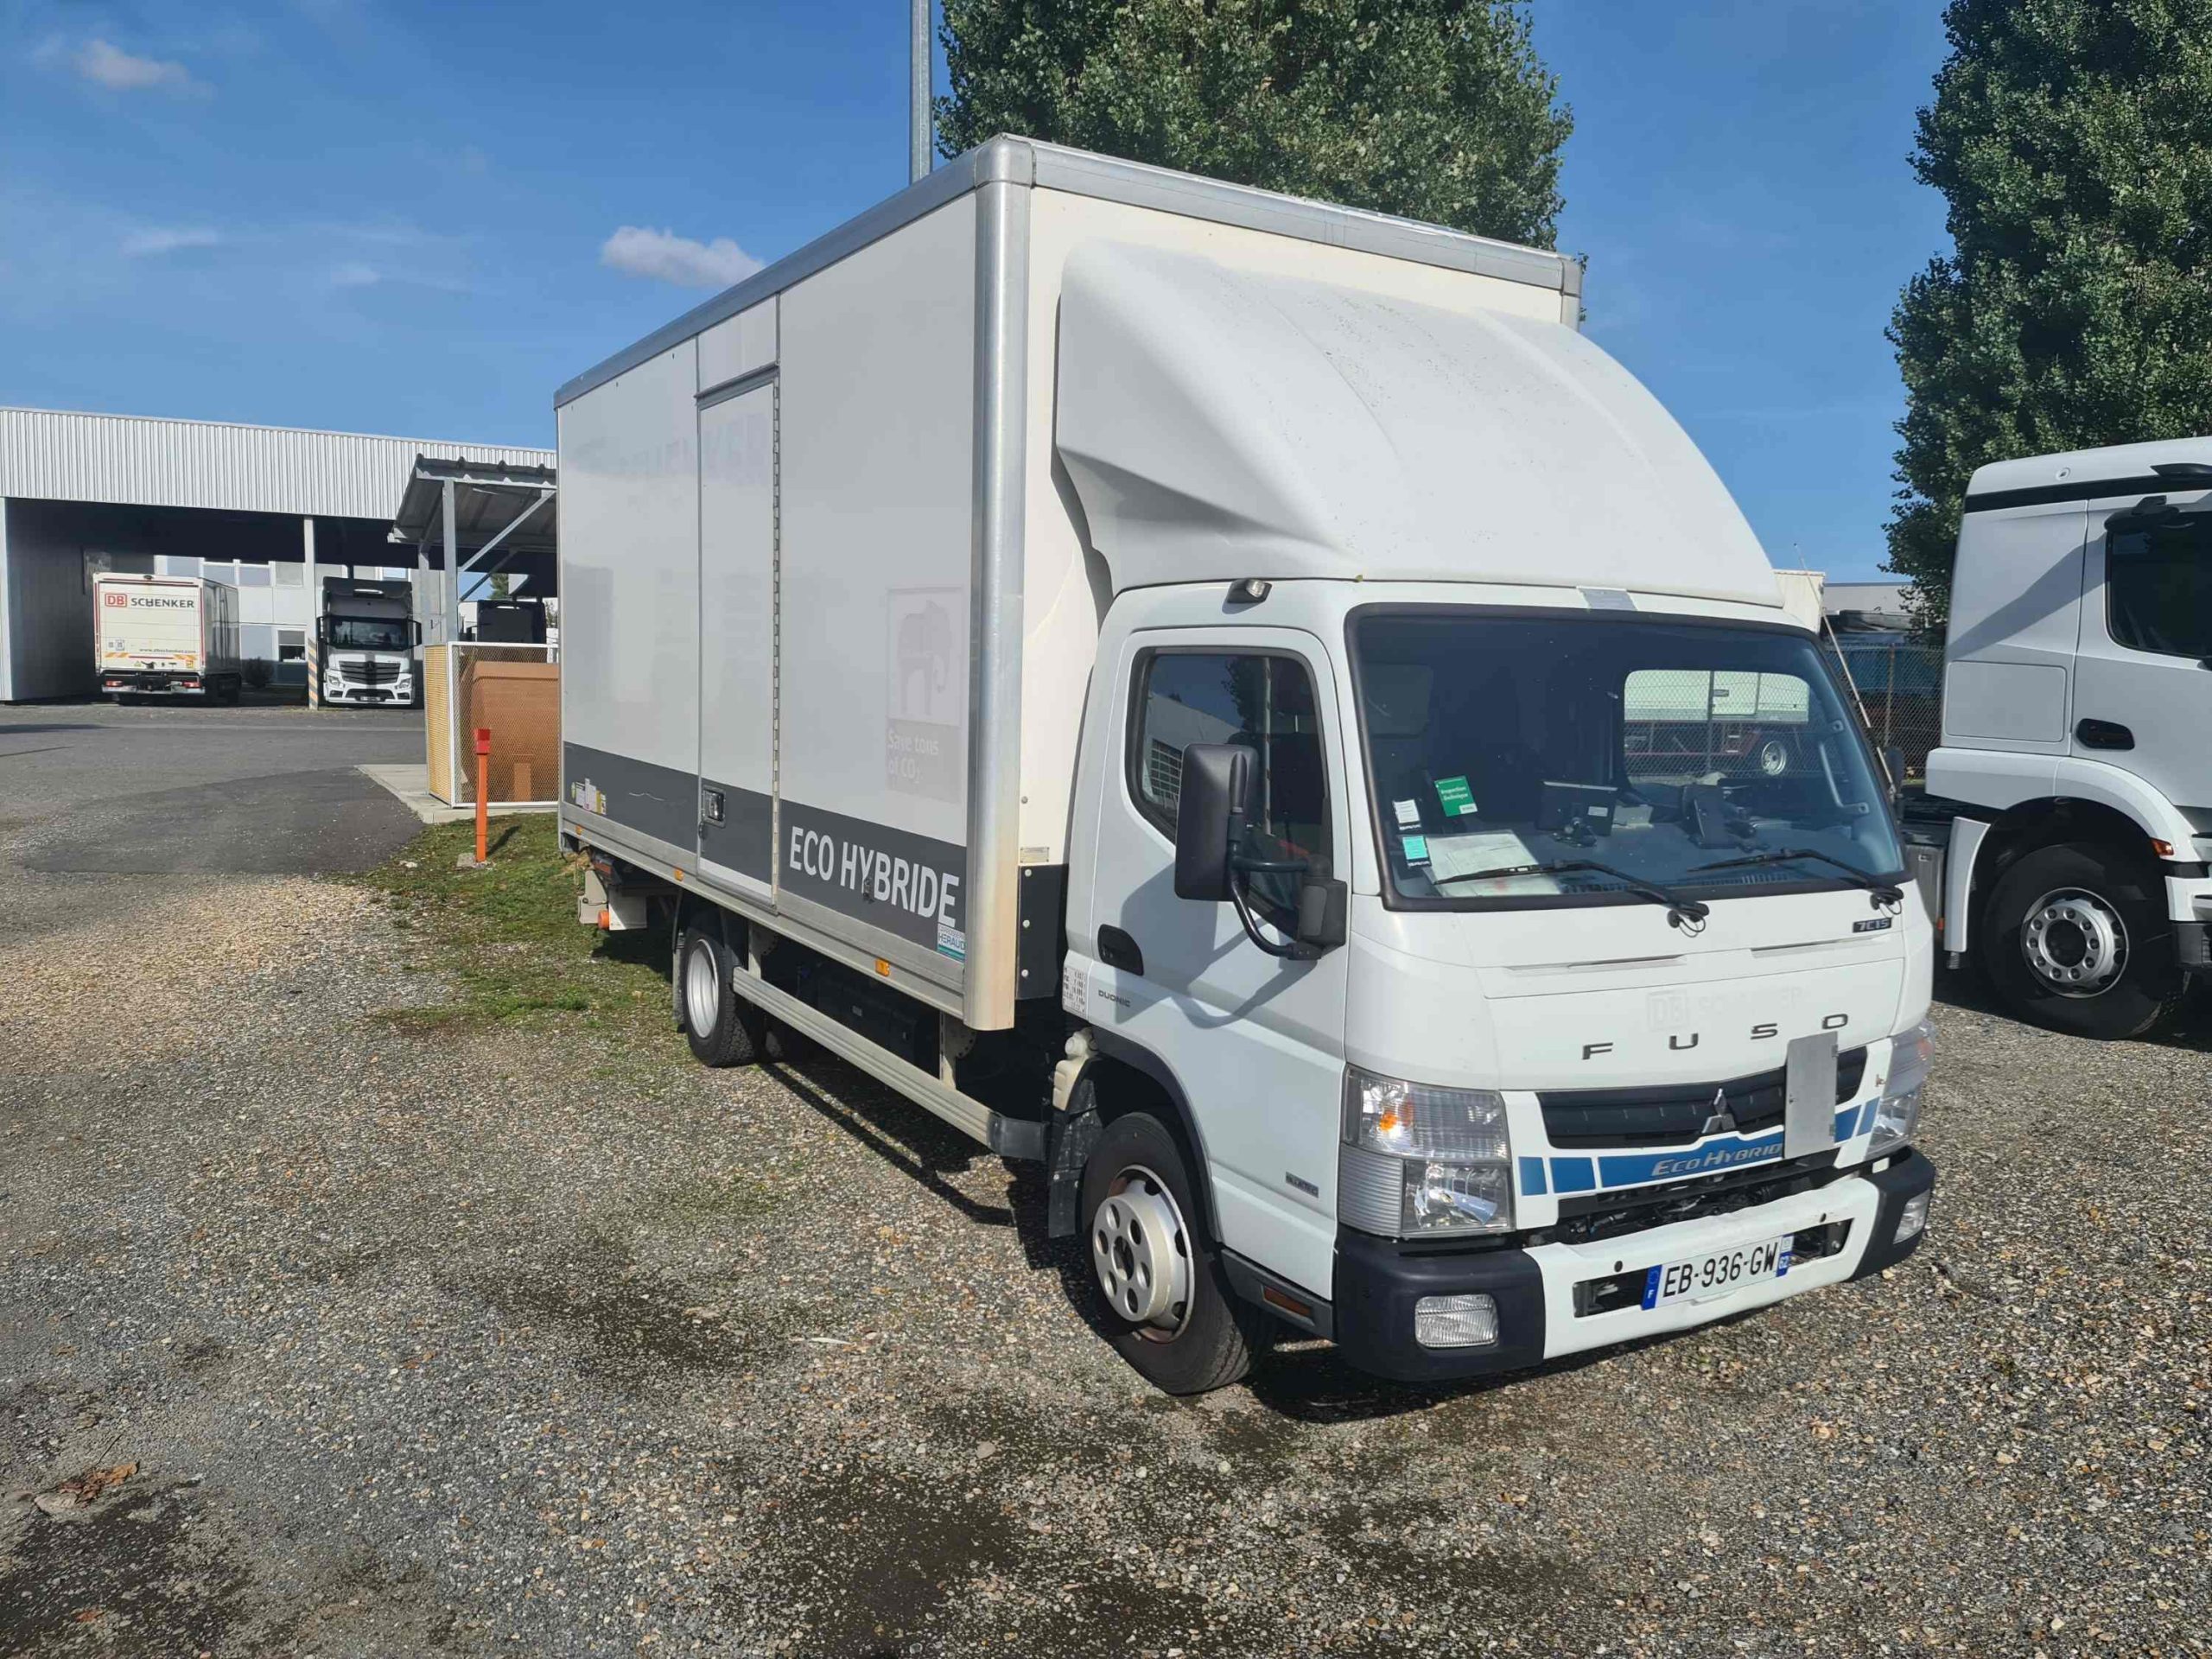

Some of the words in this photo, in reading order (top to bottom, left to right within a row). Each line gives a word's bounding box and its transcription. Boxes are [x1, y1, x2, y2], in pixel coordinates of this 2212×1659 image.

[106, 594, 126, 606] DB
[130, 597, 194, 608] SCHENKER
[790, 826, 835, 881] ECO
[840, 842, 960, 927] HYBRIDE
[1857, 918, 1890, 931] 7C15
[1098, 989, 1131, 1008] DUONIC
[1582, 1014, 1848, 1060] FUSO
[1663, 1242, 1778, 1298] EB-936-GW
